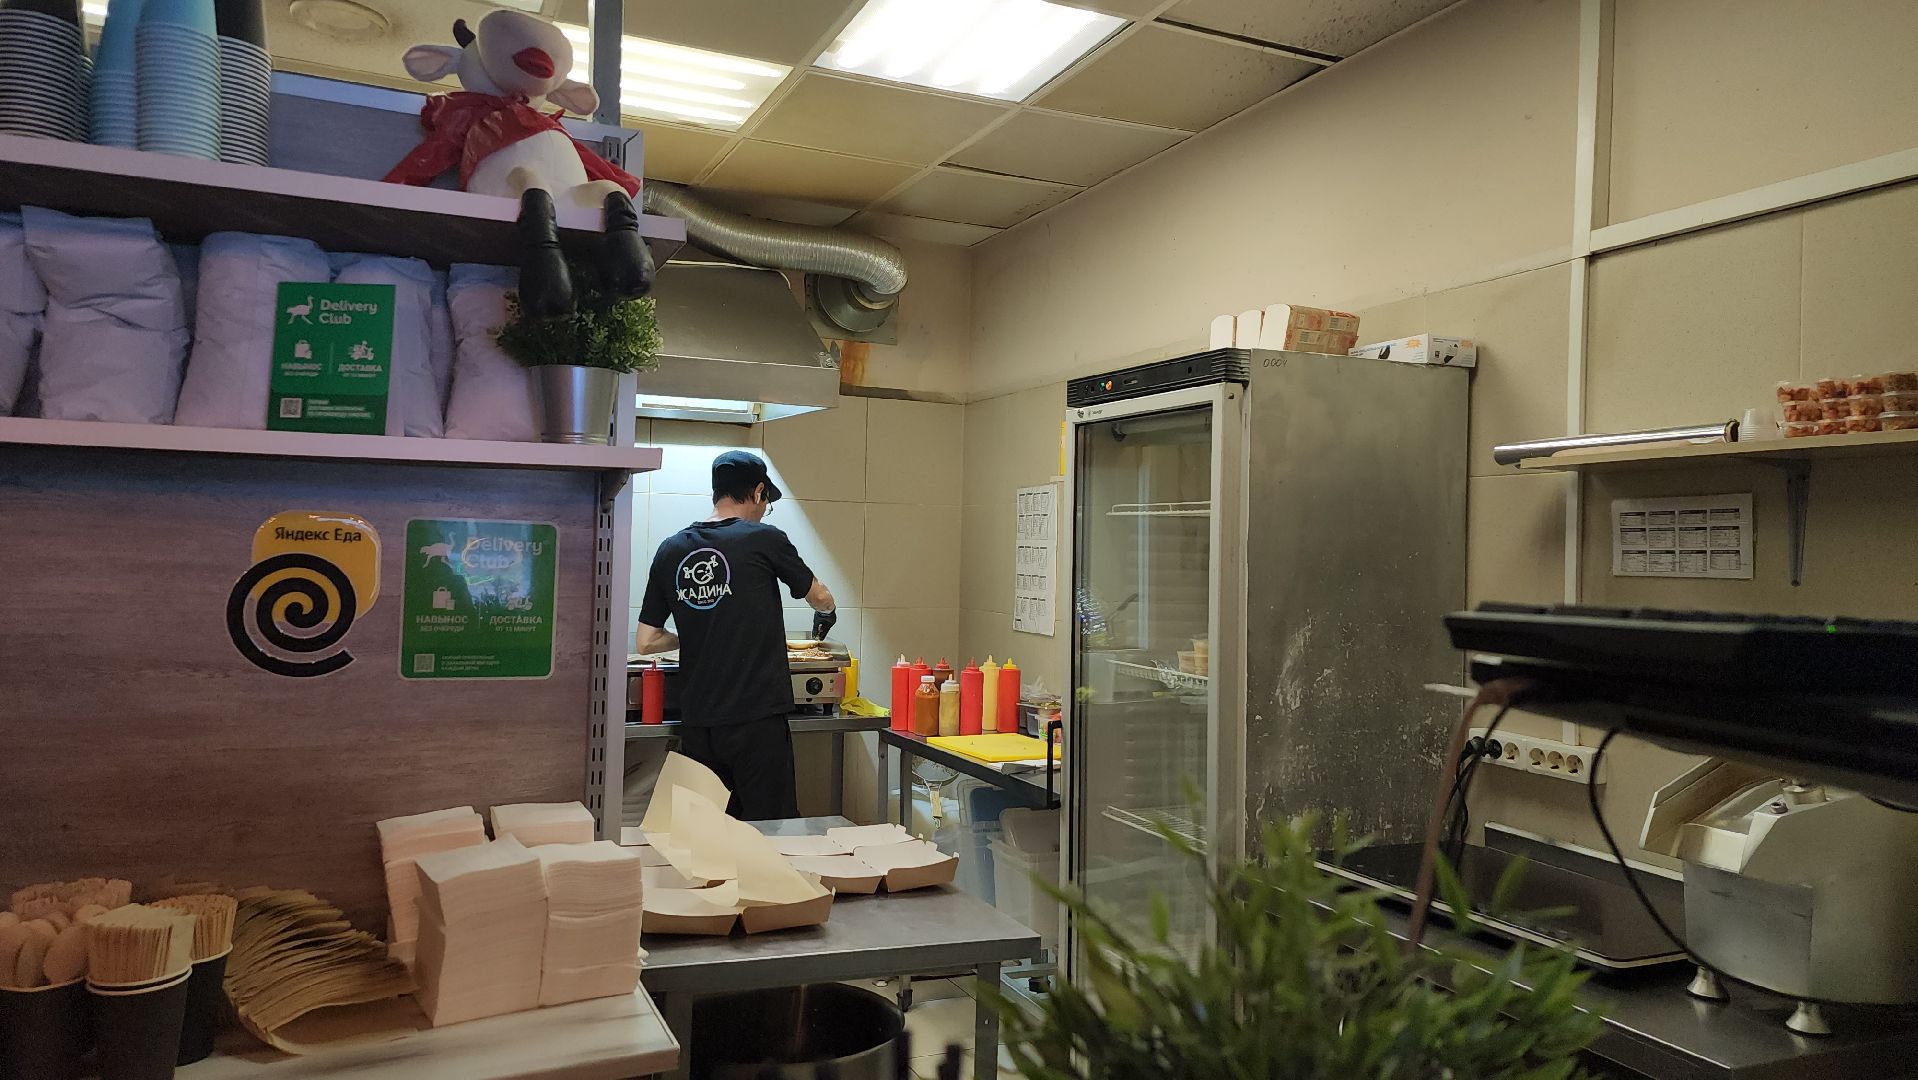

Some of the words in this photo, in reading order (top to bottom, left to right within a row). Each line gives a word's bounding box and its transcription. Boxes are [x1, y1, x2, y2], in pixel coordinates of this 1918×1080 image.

[320, 299, 378, 315] Delivery
[319, 313, 352, 325] Club
[338, 364, 383, 372] ДОСТАВКА
[274, 526, 329, 541] Яндекс
[333, 527, 362, 543] Еда
[467, 536, 543, 556] Delivery
[466, 553, 510, 569] Club
[676, 584, 732, 601] ЖАДИНА
[415, 615, 469, 624] НАВЫНОС
[489, 615, 543, 625] ДОСТАВКА
